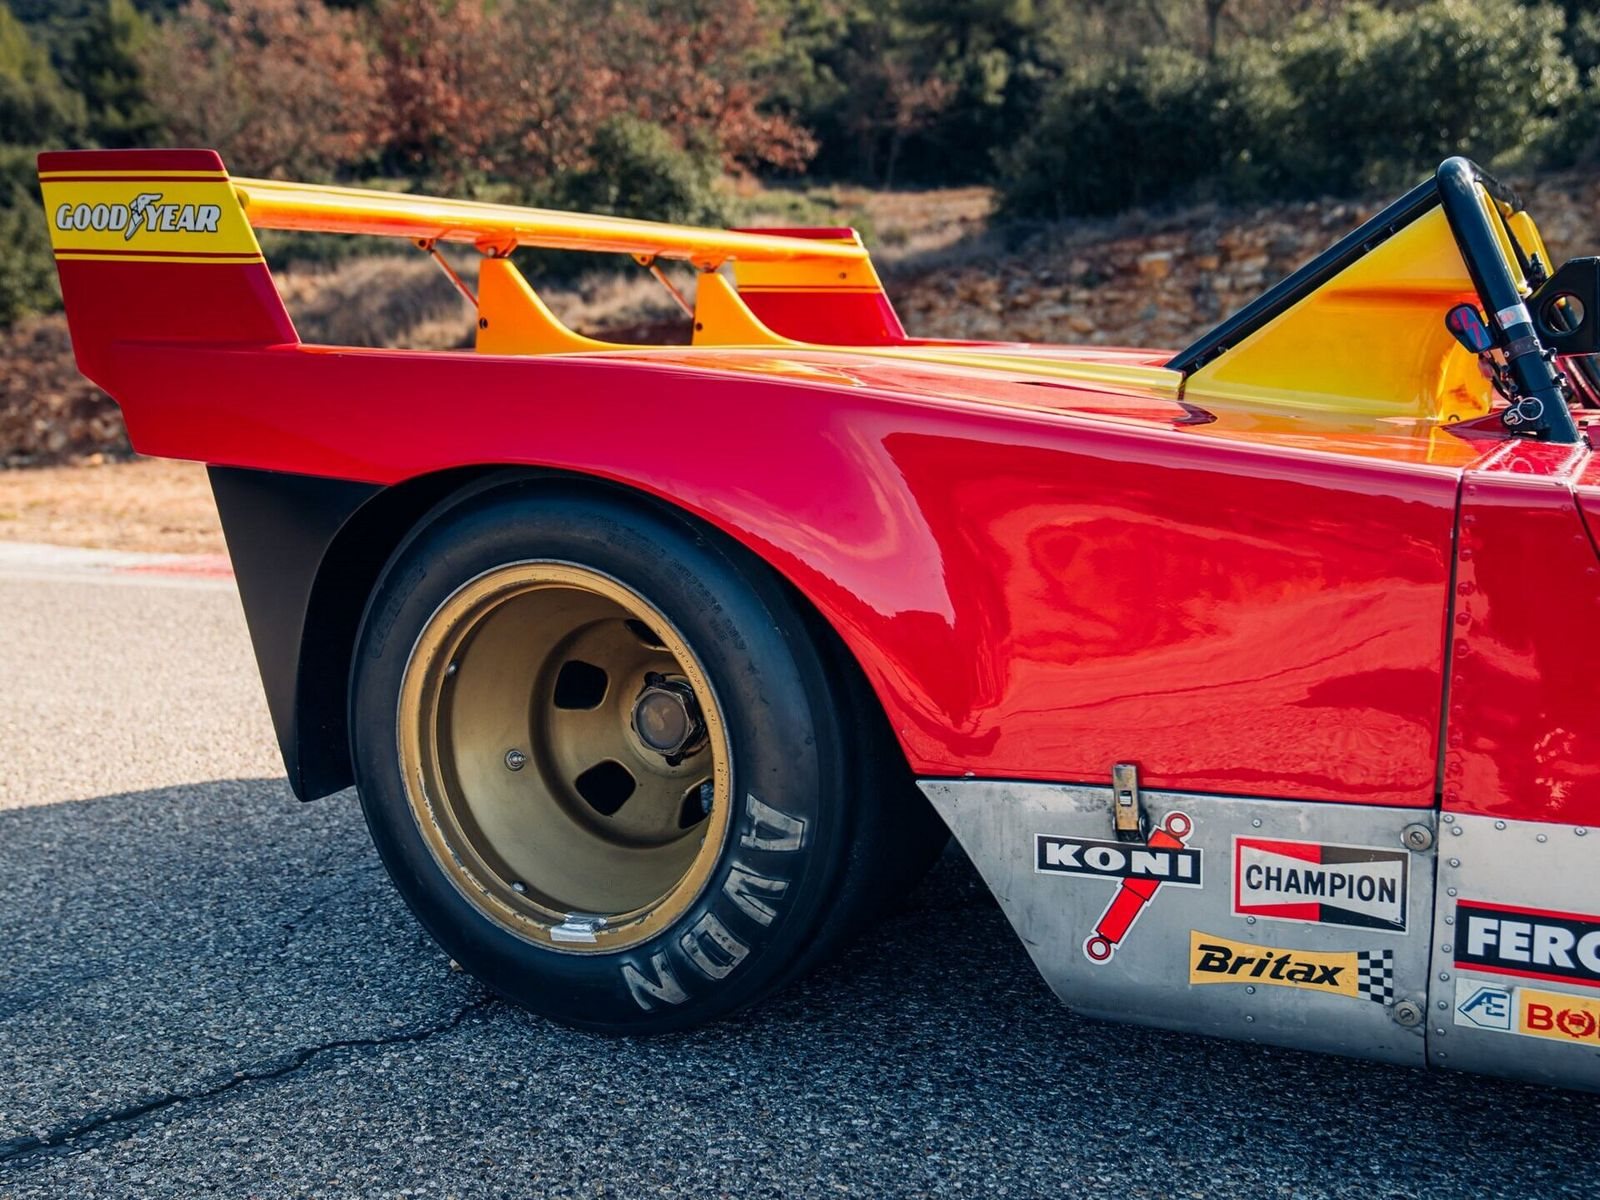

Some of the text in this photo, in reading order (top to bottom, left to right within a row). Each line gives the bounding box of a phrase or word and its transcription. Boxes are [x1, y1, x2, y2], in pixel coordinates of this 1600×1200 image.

[1045, 842, 1193, 879] KONI
[620, 793, 807, 1012] AVON
[1245, 863, 1397, 904] CHAMPION
[1196, 944, 1345, 987] Britax
[1527, 1003, 1600, 1038] BO
